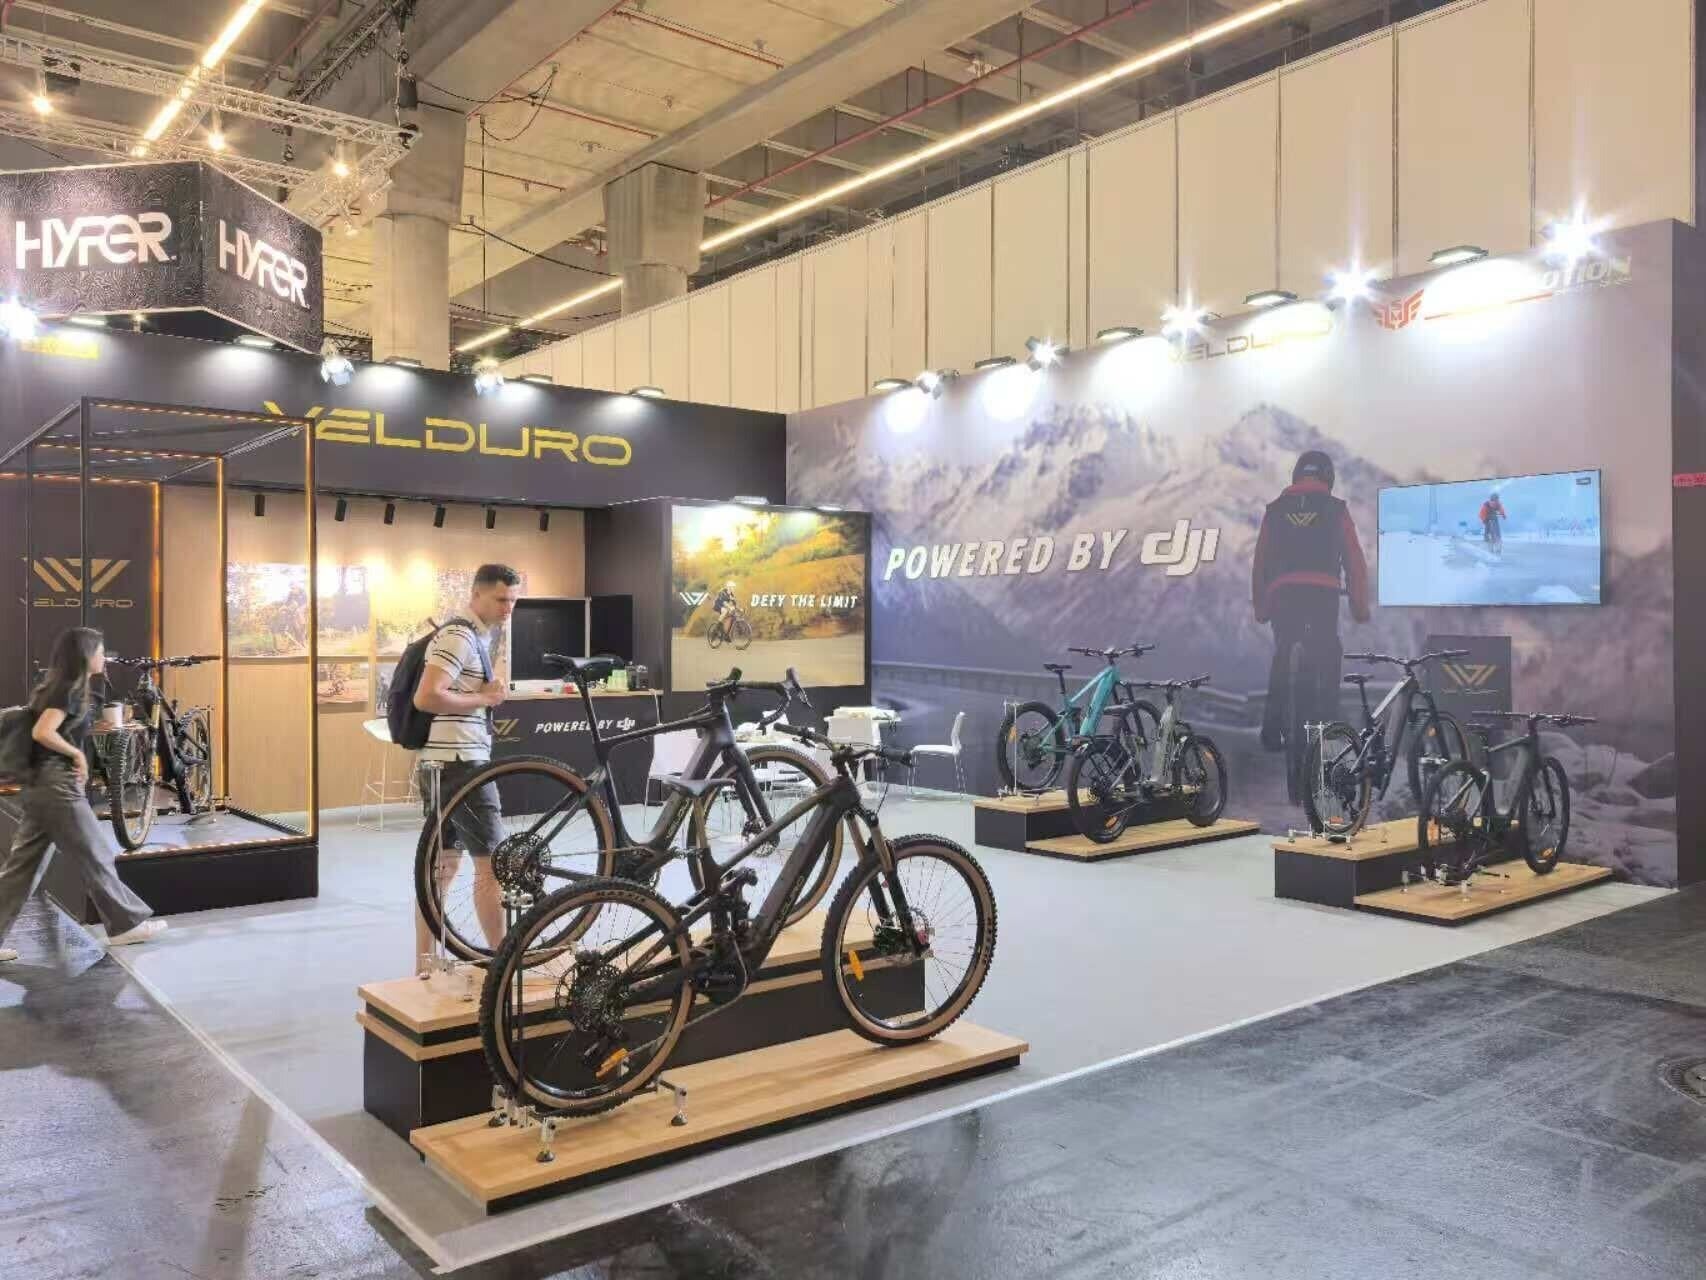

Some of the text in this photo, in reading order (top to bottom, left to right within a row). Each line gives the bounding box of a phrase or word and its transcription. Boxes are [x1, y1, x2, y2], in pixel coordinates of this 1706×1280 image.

[883, 536, 1055, 581] POWERED
[1067, 528, 1128, 572] BY
[750, 593, 858, 608] DEFY THE LIMIT
[597, 719, 614, 730] BY
